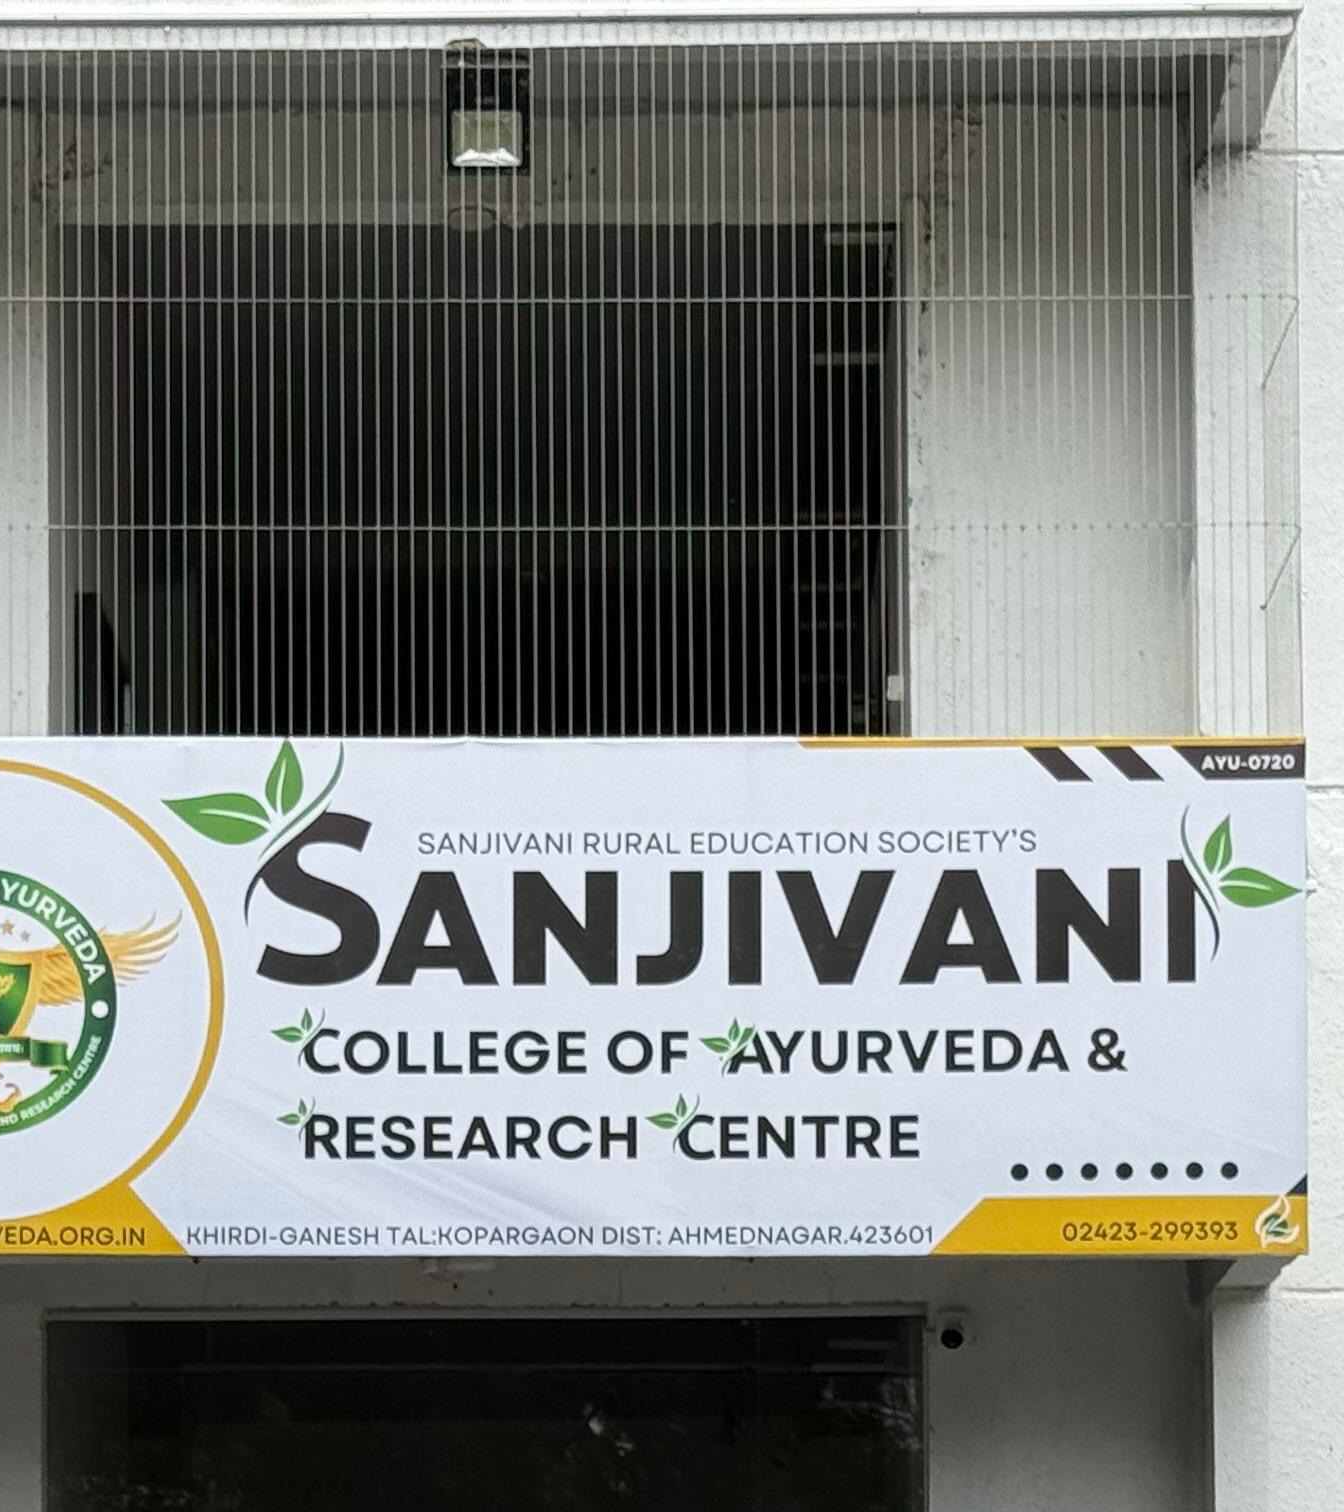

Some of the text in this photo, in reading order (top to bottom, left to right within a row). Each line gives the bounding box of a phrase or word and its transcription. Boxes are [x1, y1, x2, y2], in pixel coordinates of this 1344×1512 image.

[1201, 753, 1296, 771] AYU-0720
[417, 831, 573, 855] SANJIVANI
[583, 831, 681, 855] RURAL
[690, 830, 867, 854] EDUCATION
[256, 810, 1197, 987] SANJIVANI
[303, 1027, 1129, 1075] COLLEGE OF AYURVEDA &
[20, 1081, 75, 1121] RESEARCH
[304, 1114, 920, 1160] RESEARCH CENTRE
[186, 1226, 380, 1246] KHIRDI-GANESH
[602, 1226, 662, 1246] DIST:
[668, 1225, 933, 1246] AHMEDNAGAR.423601
[1062, 1220, 1238, 1243] 02423-299393
